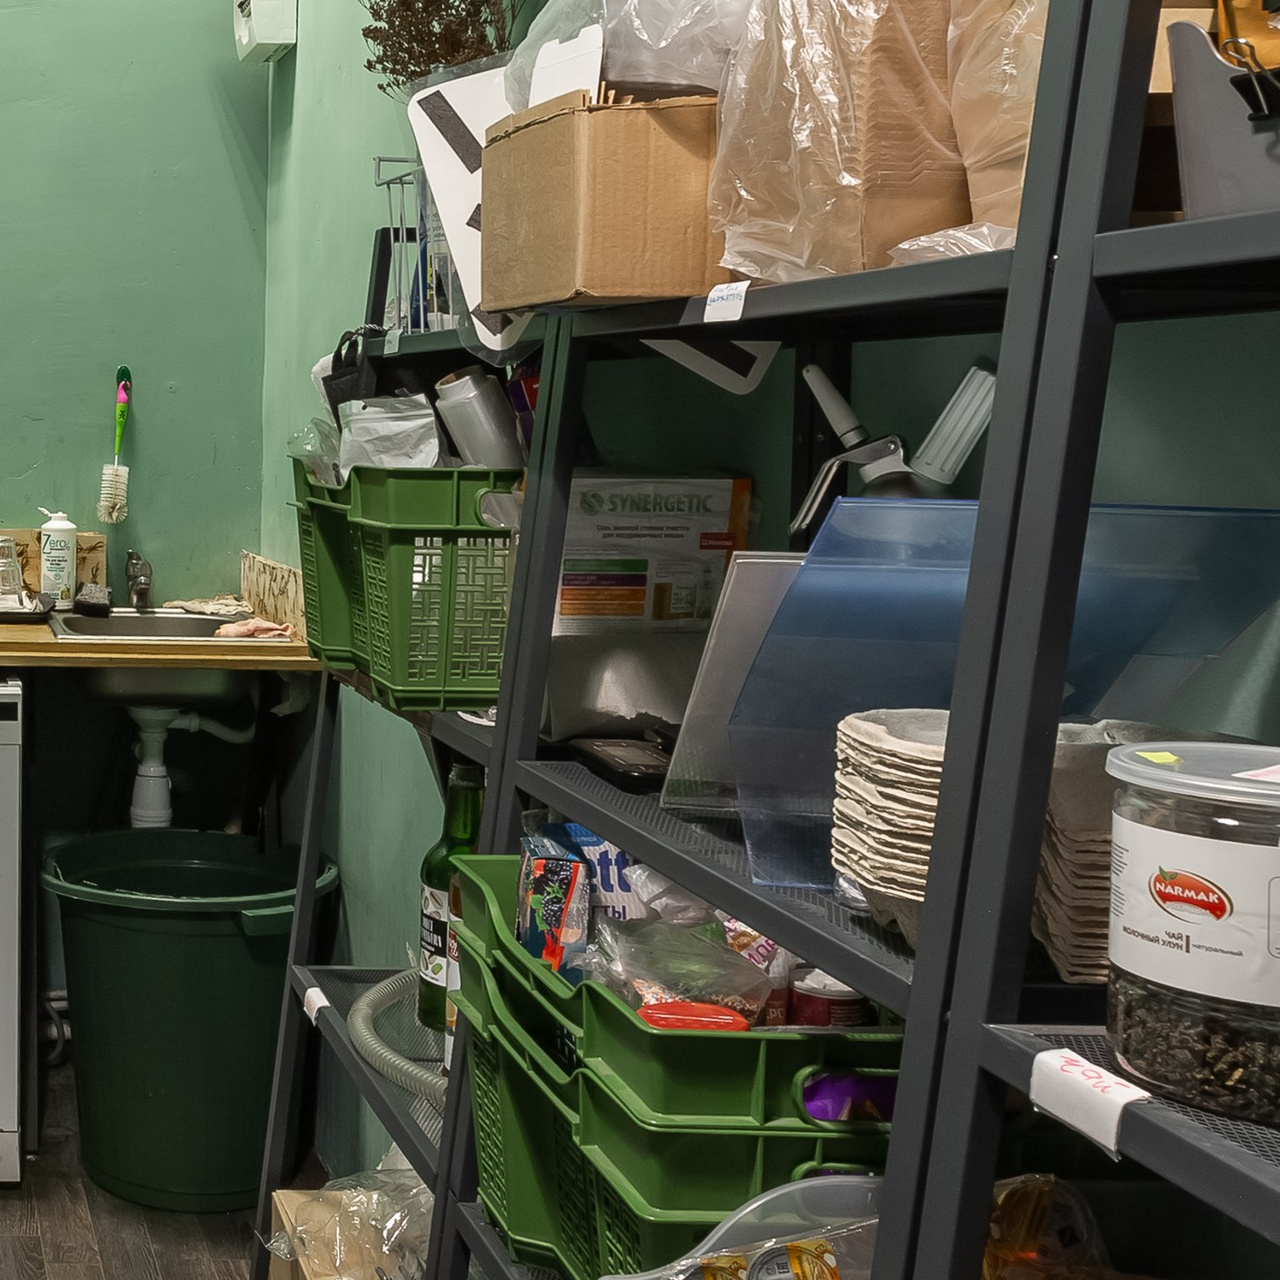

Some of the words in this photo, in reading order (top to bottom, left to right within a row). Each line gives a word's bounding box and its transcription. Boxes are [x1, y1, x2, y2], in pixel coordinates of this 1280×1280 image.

[608, 493, 713, 513] SYNERGETIC
[1156, 881, 1219, 904] NARMAK
[1122, 925, 1160, 944] МОЛОЧНЫЙ
[1161, 939, 1183, 951] УЛУН
[1164, 930, 1183, 942] ЧАЙ
[1192, 943, 1243, 957] натуральный
